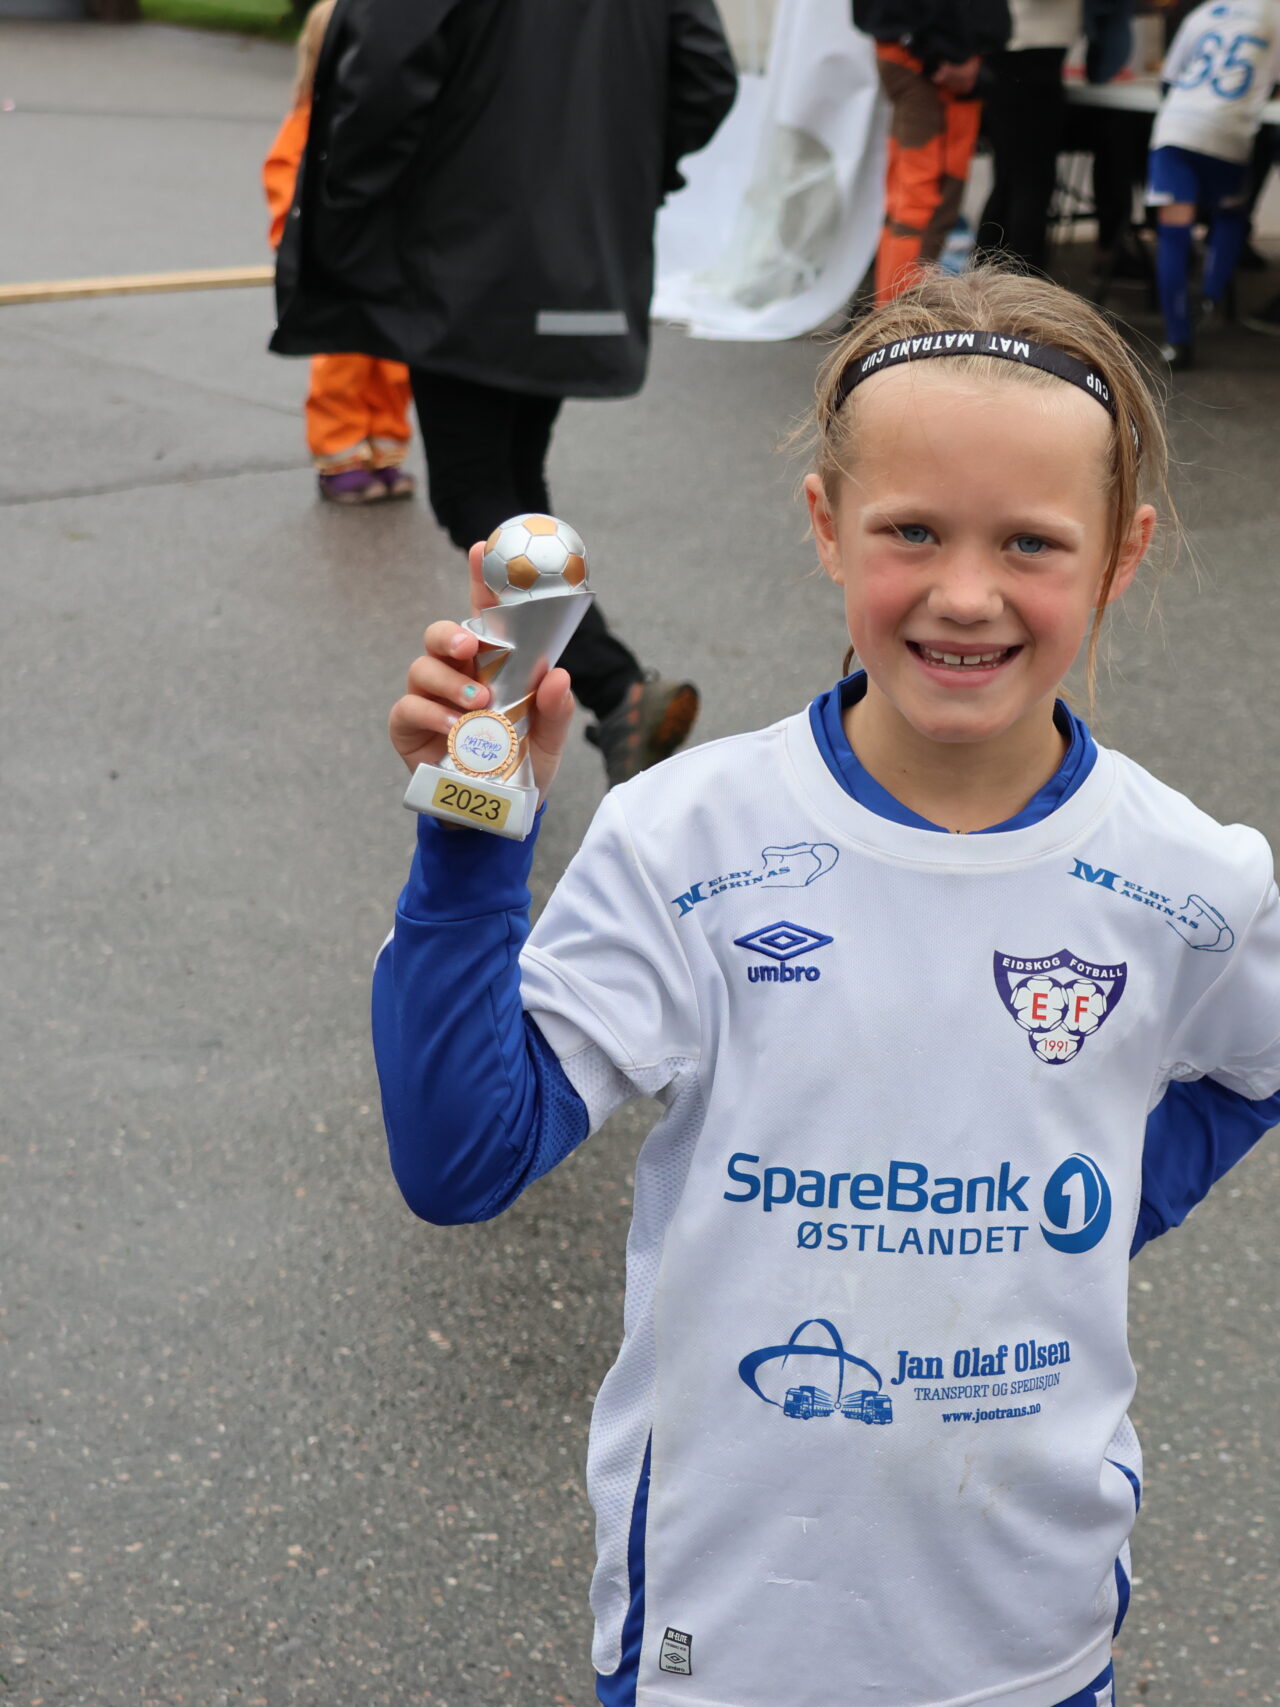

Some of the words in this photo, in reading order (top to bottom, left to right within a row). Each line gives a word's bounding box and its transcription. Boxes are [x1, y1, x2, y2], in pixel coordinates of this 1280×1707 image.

[890, 333, 975, 359] MATRAND
[989, 336, 1029, 358] MAT
[861, 348, 886, 373] CUP
[1086, 373, 1109, 400] CUP
[440, 784, 502, 820] 2023
[747, 961, 821, 983] umbro
[1002, 957, 1060, 971] EIDSKOG
[1069, 958, 1123, 978] FOTBALL
[1032, 992, 1048, 1021] E
[1074, 995, 1090, 1023] F
[1044, 1039, 1069, 1053] 1991
[723, 1152, 1031, 1214] SpareBank
[796, 1220, 1030, 1256] ØSTLANDET
[890, 1350, 944, 1386] Jan
[953, 1344, 1009, 1379] Olaf
[1015, 1339, 1071, 1373] Olsen
[914, 1384, 990, 1401] TRANSPORT
[992, 1383, 1008, 1397] OG
[1010, 1372, 1061, 1395] SPEDISJON
[942, 1402, 1042, 1424] www.jootrans.no
